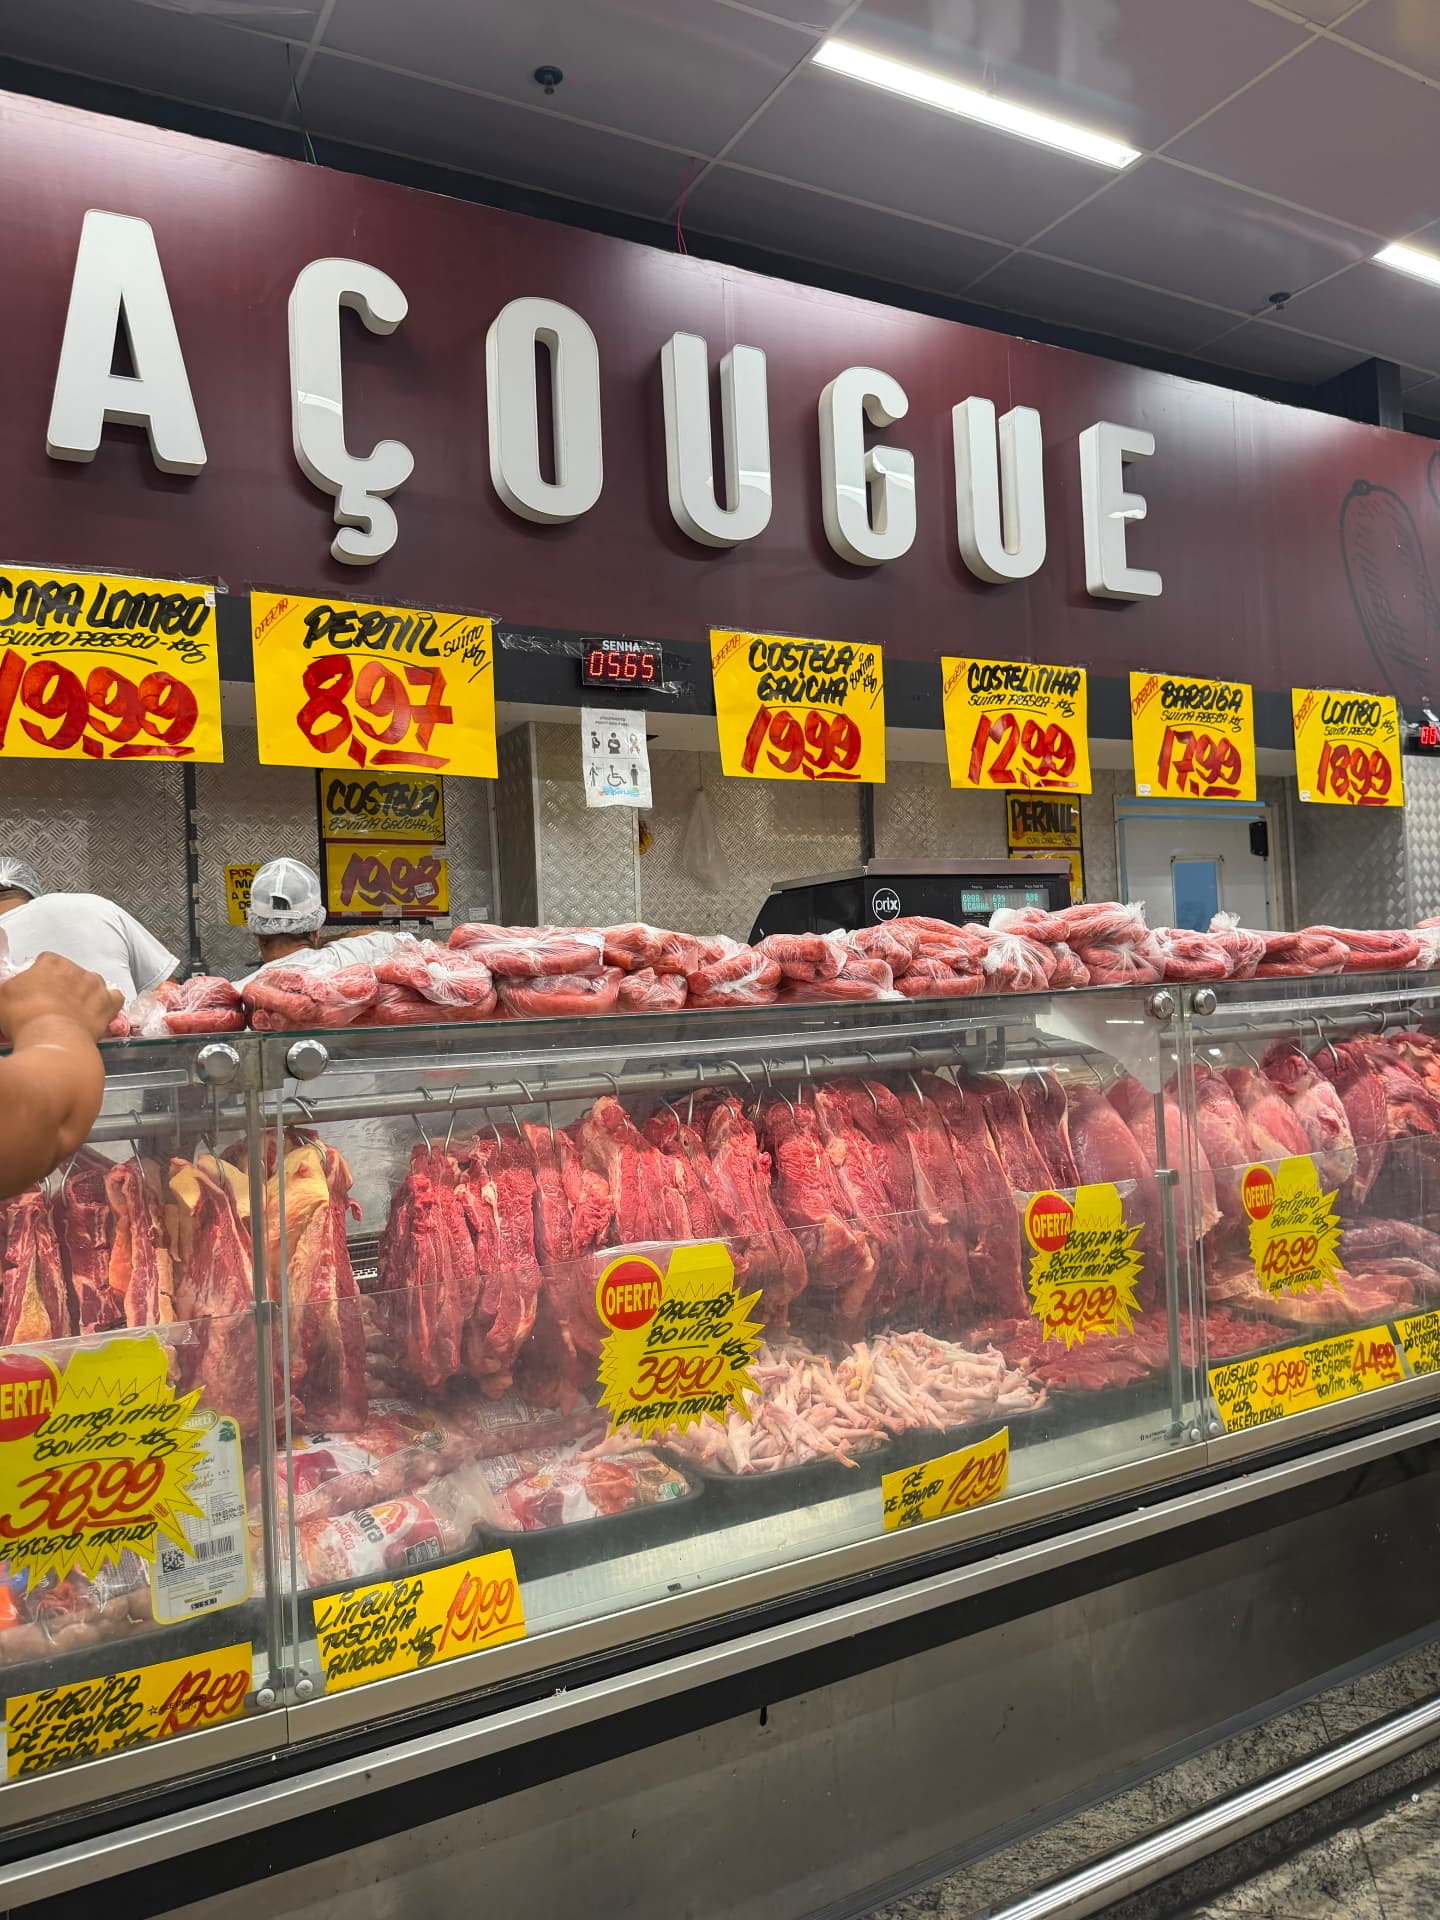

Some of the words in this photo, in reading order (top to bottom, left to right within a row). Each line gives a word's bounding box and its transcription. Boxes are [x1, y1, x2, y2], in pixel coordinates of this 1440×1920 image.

[46, 208, 1163, 600] AÇOUGUE
[0, 578, 84, 627] COPA
[87, 582, 211, 636] LOMBO
[254, 598, 290, 642] OFERTA
[75, 632, 158, 653] FRESCO
[302, 605, 441, 657] PERNIL
[602, 640, 640, 652] SENHA
[589, 650, 655, 679] 0565
[713, 634, 741, 670] OFERTA
[748, 639, 854, 674] COSTELA
[943, 661, 967, 695] OFERTA
[967, 662, 1081, 697] COSTELINHA
[1132, 676, 1158, 715] OFERTA
[0, 647, 199, 760] 19,99
[296, 655, 453, 768] 8,97
[1008, 695, 1050, 707] FRESCA
[1161, 681, 1244, 713] BARRIGA
[1321, 695, 1381, 727] LOMBO
[741, 704, 861, 780] 19,99
[968, 713, 1078, 789] 12,99
[1158, 726, 1242, 797] 17,99
[1317, 741, 1392, 804] 18,99
[326, 779, 439, 819] COSTELA
[1010, 799, 1077, 833] PERNIL
[329, 813, 381, 832] BOVINA
[875, 897, 899, 913] prix
[1246, 1184, 1273, 1208] OFERTA
[1272, 1191, 1319, 1214] PATINHO
[1033, 1213, 1071, 1239] OFERTA
[1271, 1211, 1308, 1229] BOVINO
[1065, 1230, 1096, 1251] BOLA
[1097, 1234, 1110, 1245] DA
[1050, 1250, 1100, 1269] BOVINA
[606, 1282, 660, 1316] OFERTA
[1046, 1285, 1117, 1331] 39,99
[646, 1319, 733, 1347] BOVINO
[1311, 1364, 1321, 1378] DE
[1322, 1356, 1351, 1377] CARNE
[0, 1379, 52, 1419] ERTA
[1218, 1380, 1257, 1405] BOVINO
[34, 1392, 181, 1439] LOMBINHO
[34, 1431, 127, 1462] BOVINO
[0, 1457, 166, 1539] 38,99
[884, 1496, 898, 1514] DE
[316, 1580, 424, 1634] LINGUIÇA
[438, 1571, 516, 1652] 19,99
[322, 1607, 417, 1657] TOSCANA
[326, 1637, 398, 1680] AURORA
[9, 1674, 141, 1732] LINGUIÇA
[7, 1723, 48, 1757] DE
[41, 1702, 144, 1750] FRANGO
